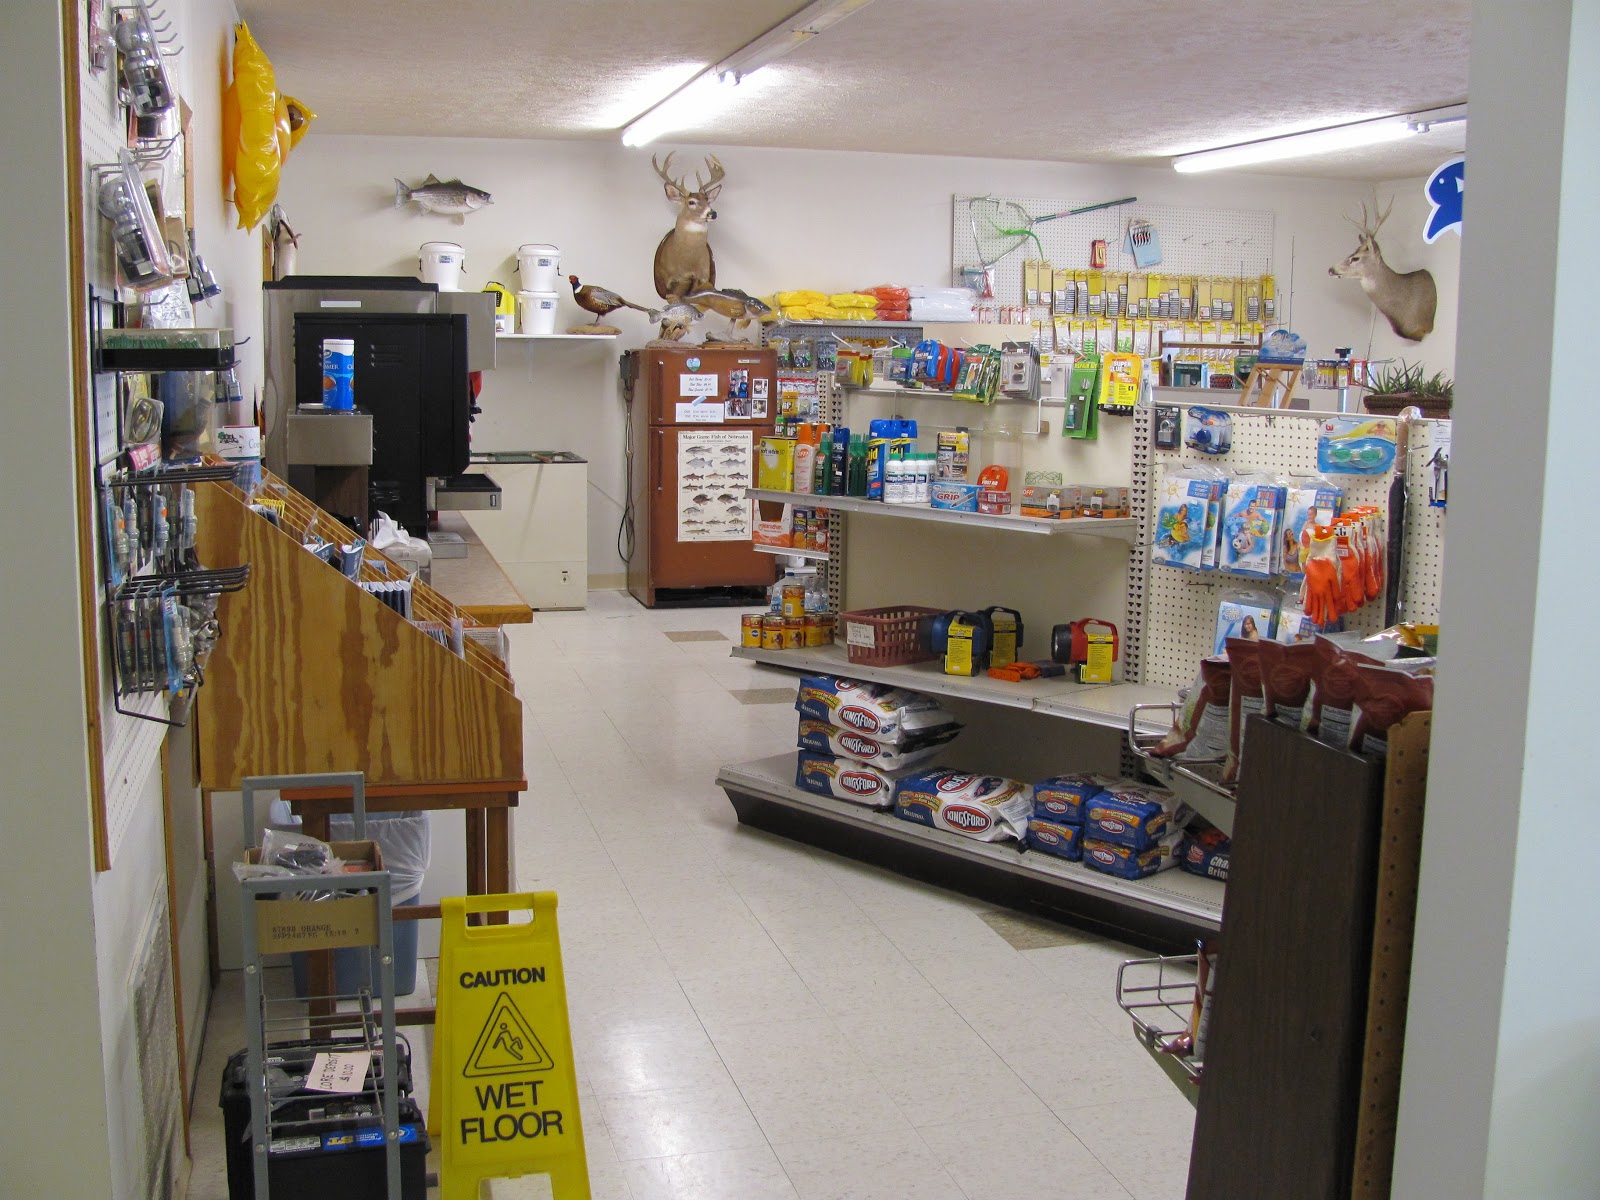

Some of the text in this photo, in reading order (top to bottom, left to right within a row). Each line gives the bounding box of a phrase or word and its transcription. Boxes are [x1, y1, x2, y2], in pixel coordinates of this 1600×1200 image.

[936, 493, 960, 501] GRIP
[842, 710, 877, 731] KINGSFORD
[841, 736, 876, 754] KINGSFORD
[843, 776, 877, 791] KINGSFORD
[946, 811, 986, 828] KINGSFORD
[459, 966, 546, 989] CAUTION
[474, 1080, 544, 1111] WET
[460, 1110, 564, 1145] FLOOR
